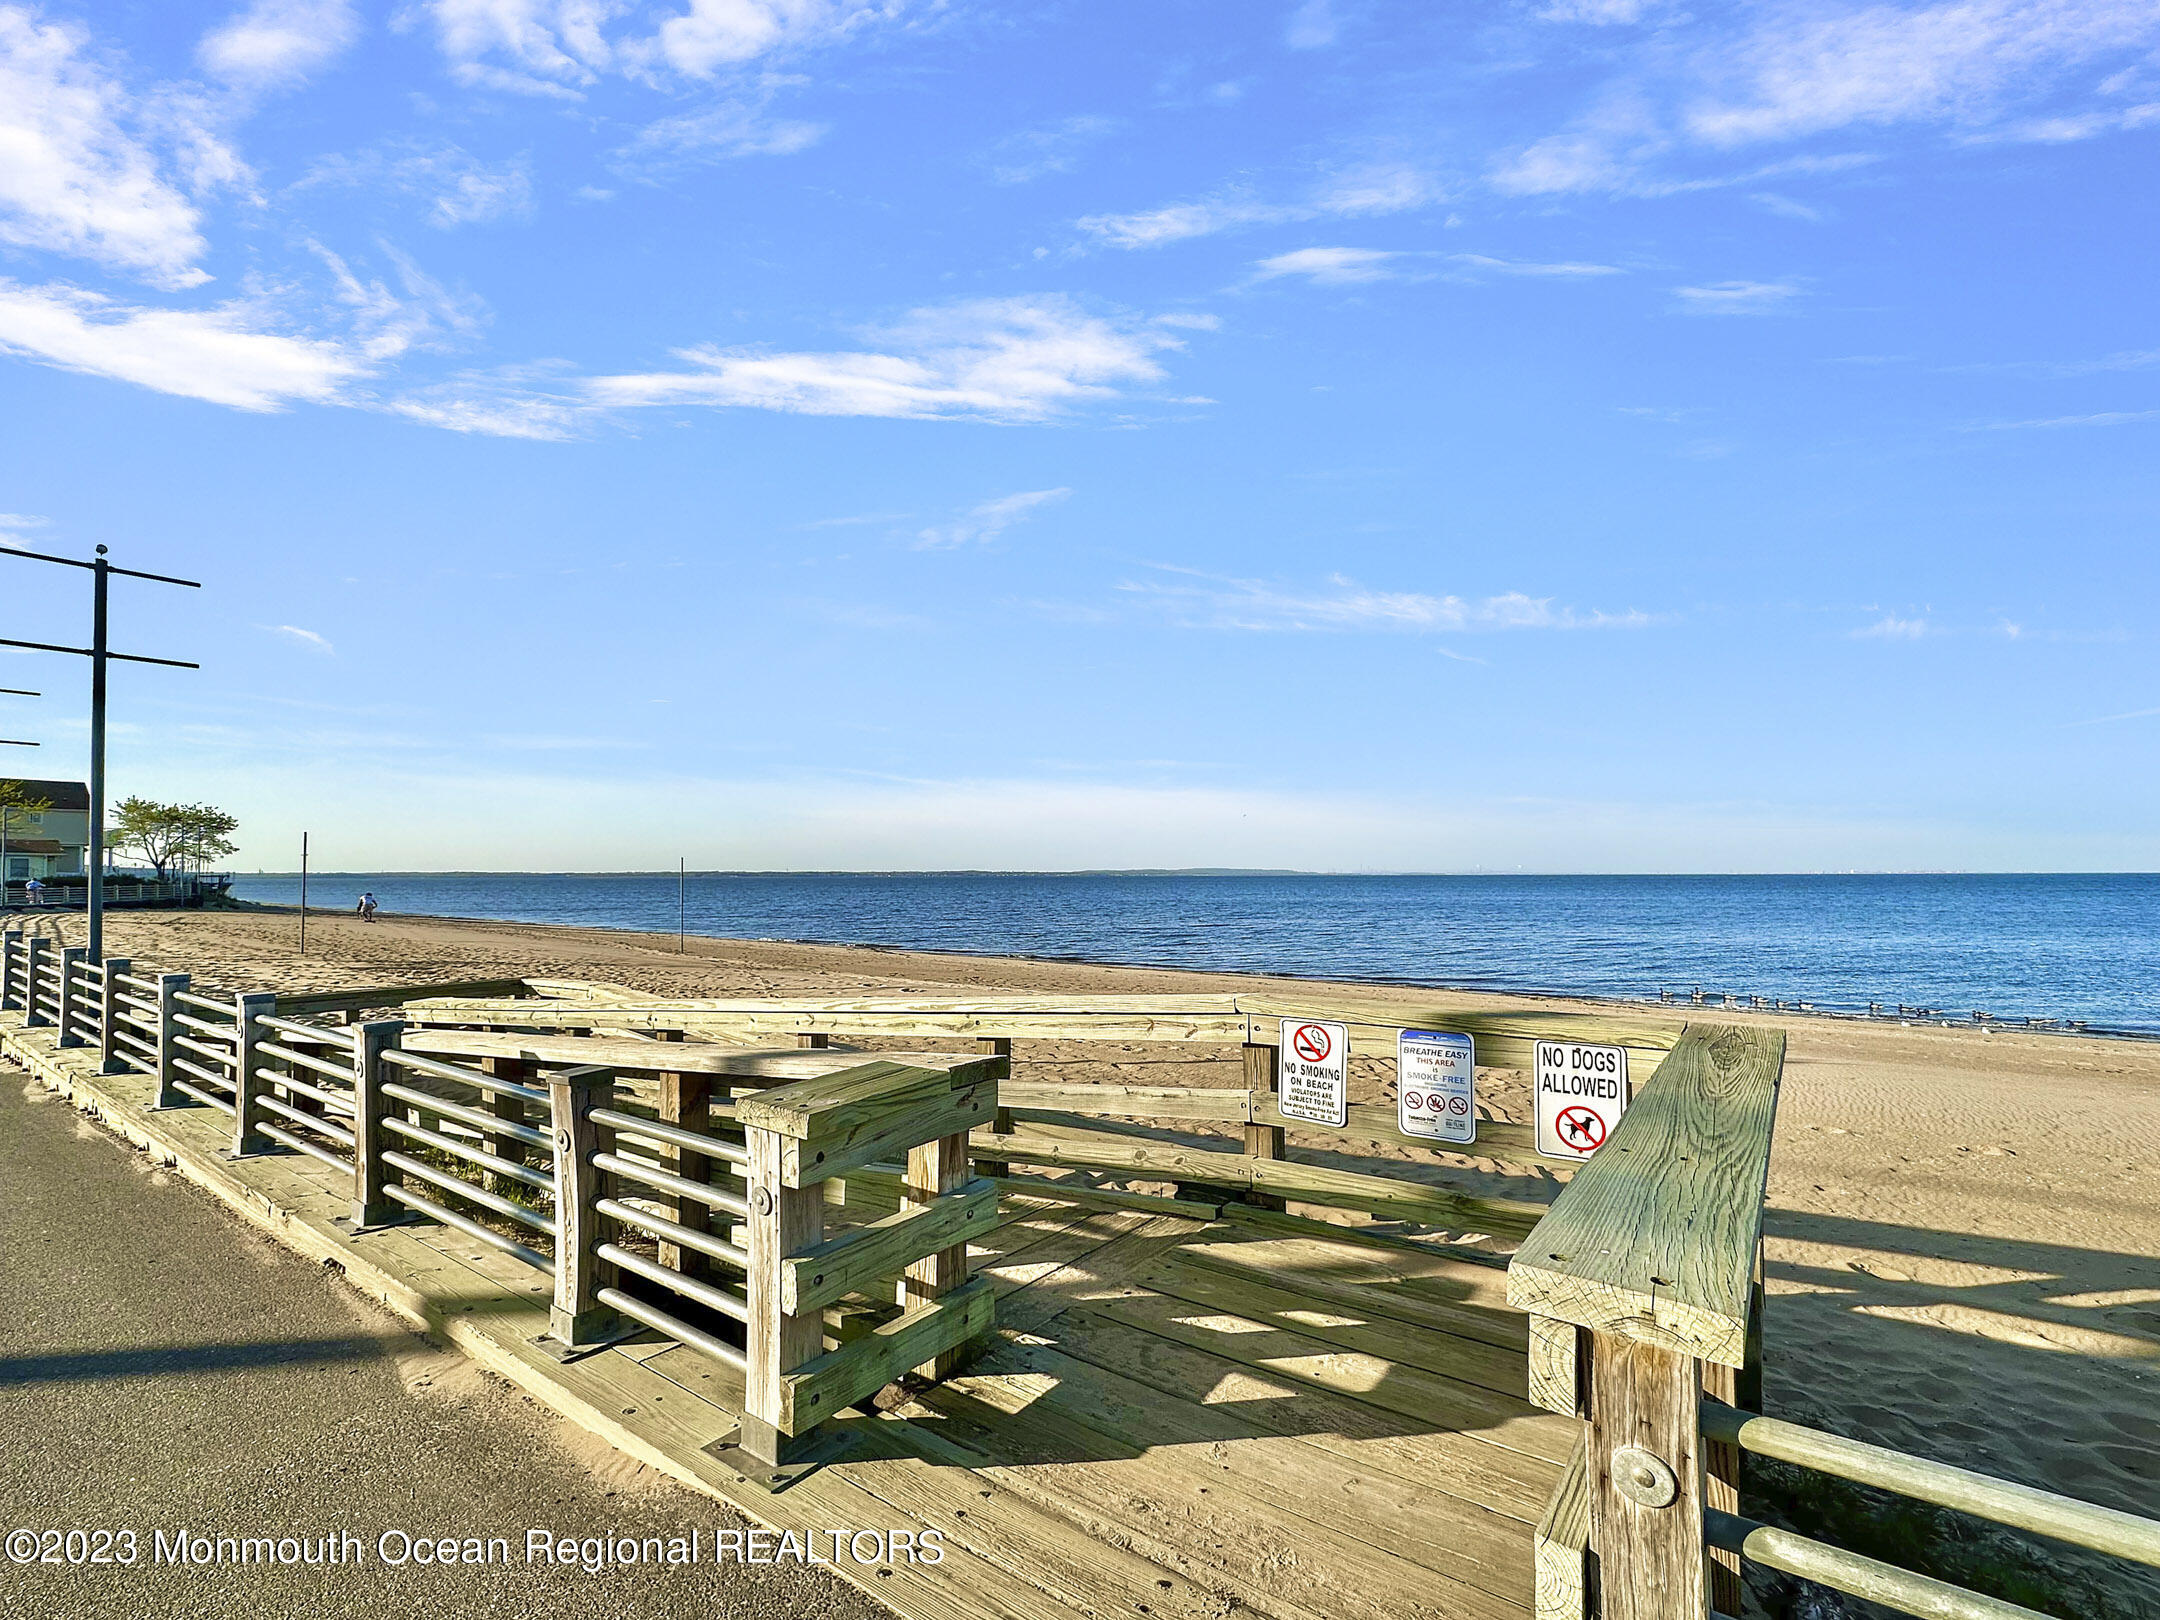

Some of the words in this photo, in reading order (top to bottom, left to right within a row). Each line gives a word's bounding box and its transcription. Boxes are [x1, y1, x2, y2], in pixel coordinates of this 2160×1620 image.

[1404, 1046, 1443, 1057] BREATHE
[1445, 1050, 1468, 1060] EASY
[1542, 1046, 1564, 1068] NO
[1572, 1048, 1616, 1073] DOGS
[1416, 1057, 1433, 1066] THIS
[1435, 1059, 1456, 1068] AREA
[1284, 1061, 1296, 1074] NO
[1300, 1064, 1340, 1081] SMOKING
[1290, 1076, 1302, 1086] ON
[1306, 1079, 1333, 1091] BEACH
[1408, 1072, 1466, 1085] SMOKE-FREE
[1542, 1072, 1618, 1099] ALLOWED
[1291, 1088, 1320, 1098] VIOLATORS
[1288, 1094, 1312, 1104] SUBJECT
[1322, 1100, 1334, 1108] FINE
